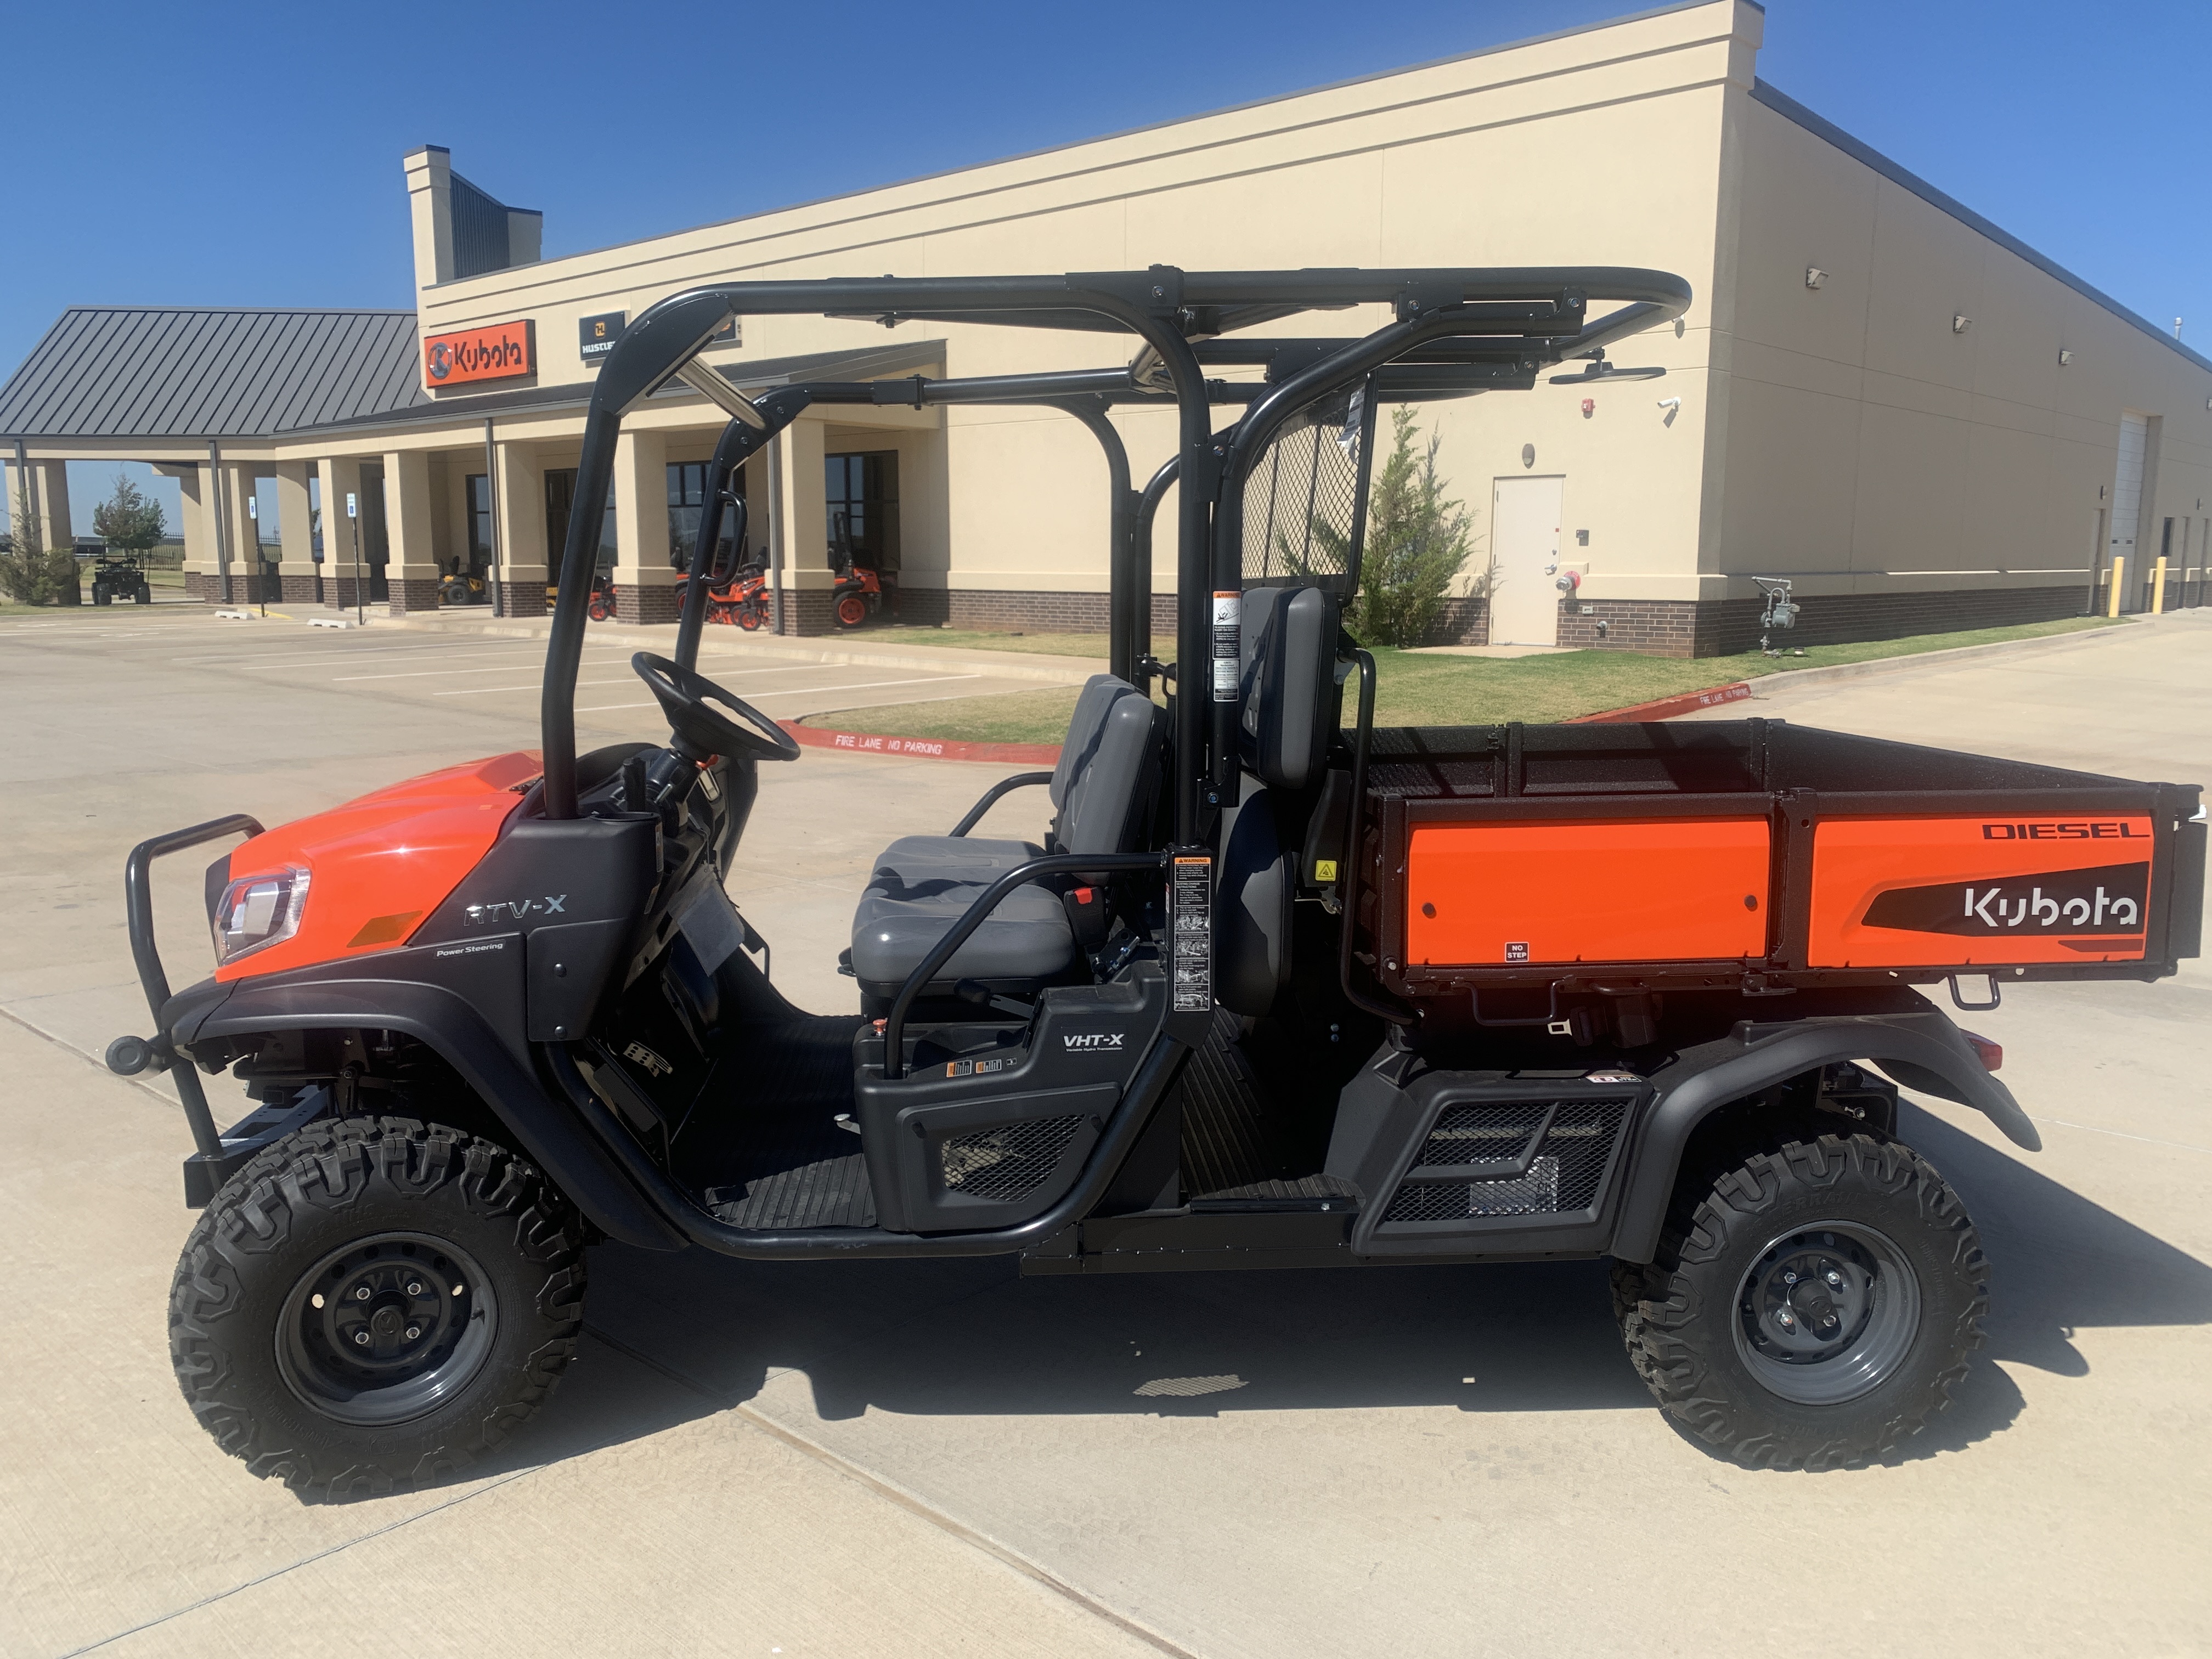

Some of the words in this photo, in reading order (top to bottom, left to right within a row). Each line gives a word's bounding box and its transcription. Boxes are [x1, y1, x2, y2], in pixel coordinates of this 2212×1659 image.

[454, 335, 522, 372] Kubota
[582, 341, 616, 354] HUSTLE
[1711, 693, 1724, 703] LANE
[835, 735, 855, 747] FIRE
[859, 737, 882, 749] LANE
[888, 740, 900, 751] NO
[904, 741, 943, 755] PARKING
[1982, 822, 2151, 839] DIESEL
[464, 894, 567, 926] RTV-X
[1964, 887, 2138, 927] Kubota
[436, 948, 464, 957] Power
[465, 943, 503, 953] Steering
[1063, 1034, 1125, 1047] VHT-X
